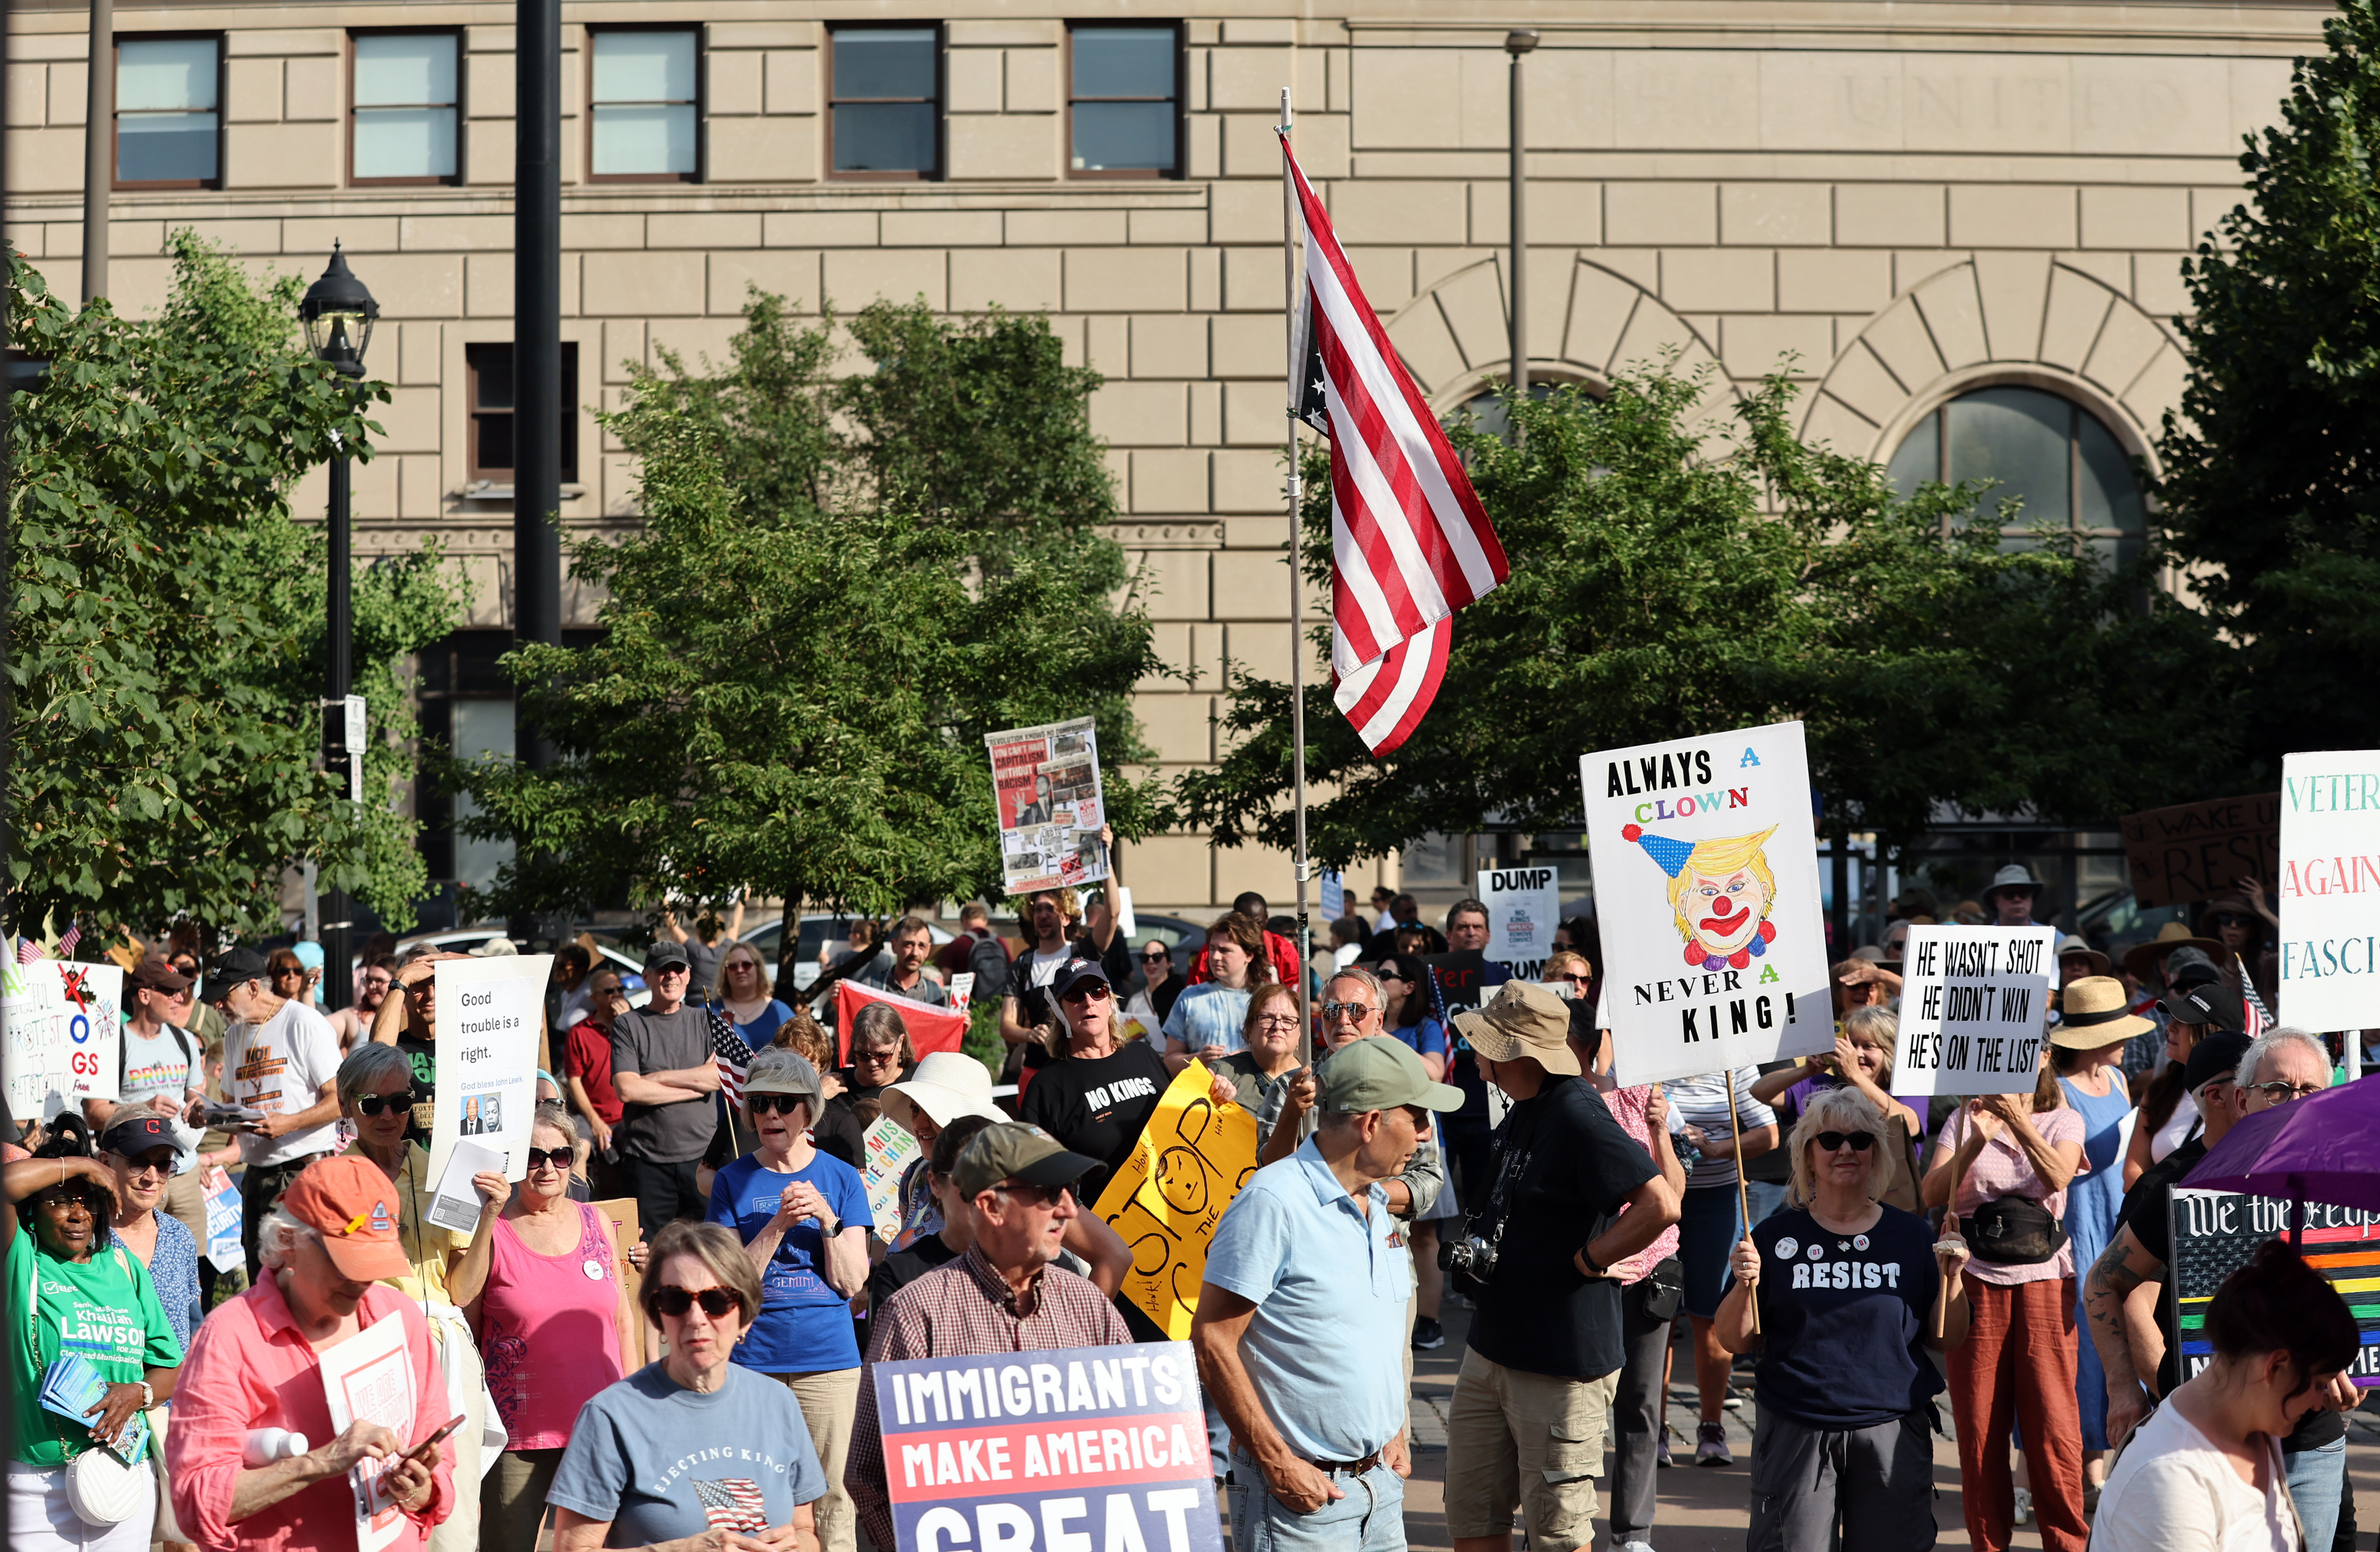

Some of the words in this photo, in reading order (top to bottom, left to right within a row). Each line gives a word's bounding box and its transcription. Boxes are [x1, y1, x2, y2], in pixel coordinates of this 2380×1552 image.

[1841, 74, 2192, 131] UNITED
[994, 748, 1009, 758] YOU
[1009, 744, 1028, 755] CAN'T
[1025, 731, 1046, 740] KNOWS
[995, 751, 1045, 769] CAPITALISM
[997, 764, 1033, 781] WITHOUT
[1608, 750, 1712, 798] ALWAYS
[1740, 747, 1760, 767] A
[999, 775, 1031, 790] RACISM
[1635, 787, 1748, 823] CLOWN
[2158, 803, 2246, 836] WAKE
[2255, 799, 2280, 826] U
[1492, 869, 1551, 891] DUMP
[2163, 834, 2280, 901] RESI
[1917, 942, 1937, 976] HE
[1945, 941, 1999, 977] WASN'T
[2006, 939, 2043, 974] SHOT
[2282, 937, 2380, 980] FASCI
[461, 991, 491, 1006] Good
[1634, 970, 1742, 1006] NEVER
[1759, 964, 1779, 984] A
[1682, 992, 1796, 1044] KING!
[1921, 985, 1942, 1020] HE
[1947, 984, 1996, 1021] DIDN'T
[2002, 987, 2030, 1023] WIN
[8, 1015, 64, 1055] PROTEST
[461, 1018, 500, 1033] trouble
[503, 1016, 511, 1028] is
[514, 1017, 519, 1027] a
[28, 1053, 46, 1076] IS
[246, 1048, 268, 1063] NO!
[461, 1047, 491, 1063] right.
[1908, 1032, 1942, 1069] HE'S
[1947, 1035, 1969, 1070] ON
[1977, 1038, 2004, 1072] THE
[2007, 1038, 2039, 1073] LIST
[10, 1072, 71, 1111] PATRIOTIC
[128, 1064, 189, 1088] PROUD
[461, 1082, 476, 1090] God
[495, 1078, 508, 1086] John
[508, 1075, 524, 1085] Lewis.
[1085, 1086, 1111, 1112] NO
[1108, 1077, 1157, 1103] KINGS
[867, 1118, 899, 1153] MUS
[866, 1165, 885, 1191] HE
[879, 1131, 915, 1169] CHAN
[1194, 1204, 1220, 1236] THE
[2182, 1194, 2239, 1237] We
[2245, 1194, 2292, 1233] the
[1809, 1248, 1821, 1256] FDT
[1855, 1237, 1868, 1248] FDT
[59, 1285, 79, 1293] Elec
[772, 1276, 815, 1289] GEMINI
[1792, 1261, 1901, 1290] RESIST
[61, 1316, 146, 1347] Lawson
[97, 1353, 129, 1364] Municipal
[355, 1383, 375, 1419] WE
[376, 1368, 397, 1406] ARE
[892, 1355, 1182, 1425] IMMIGRANTS
[653, 1447, 733, 1493] EJECTING
[901, 1437, 1013, 1488] MAKE
[1024, 1424, 1194, 1477] AMERICA
[915, 1488, 1200, 1552] GREAT
